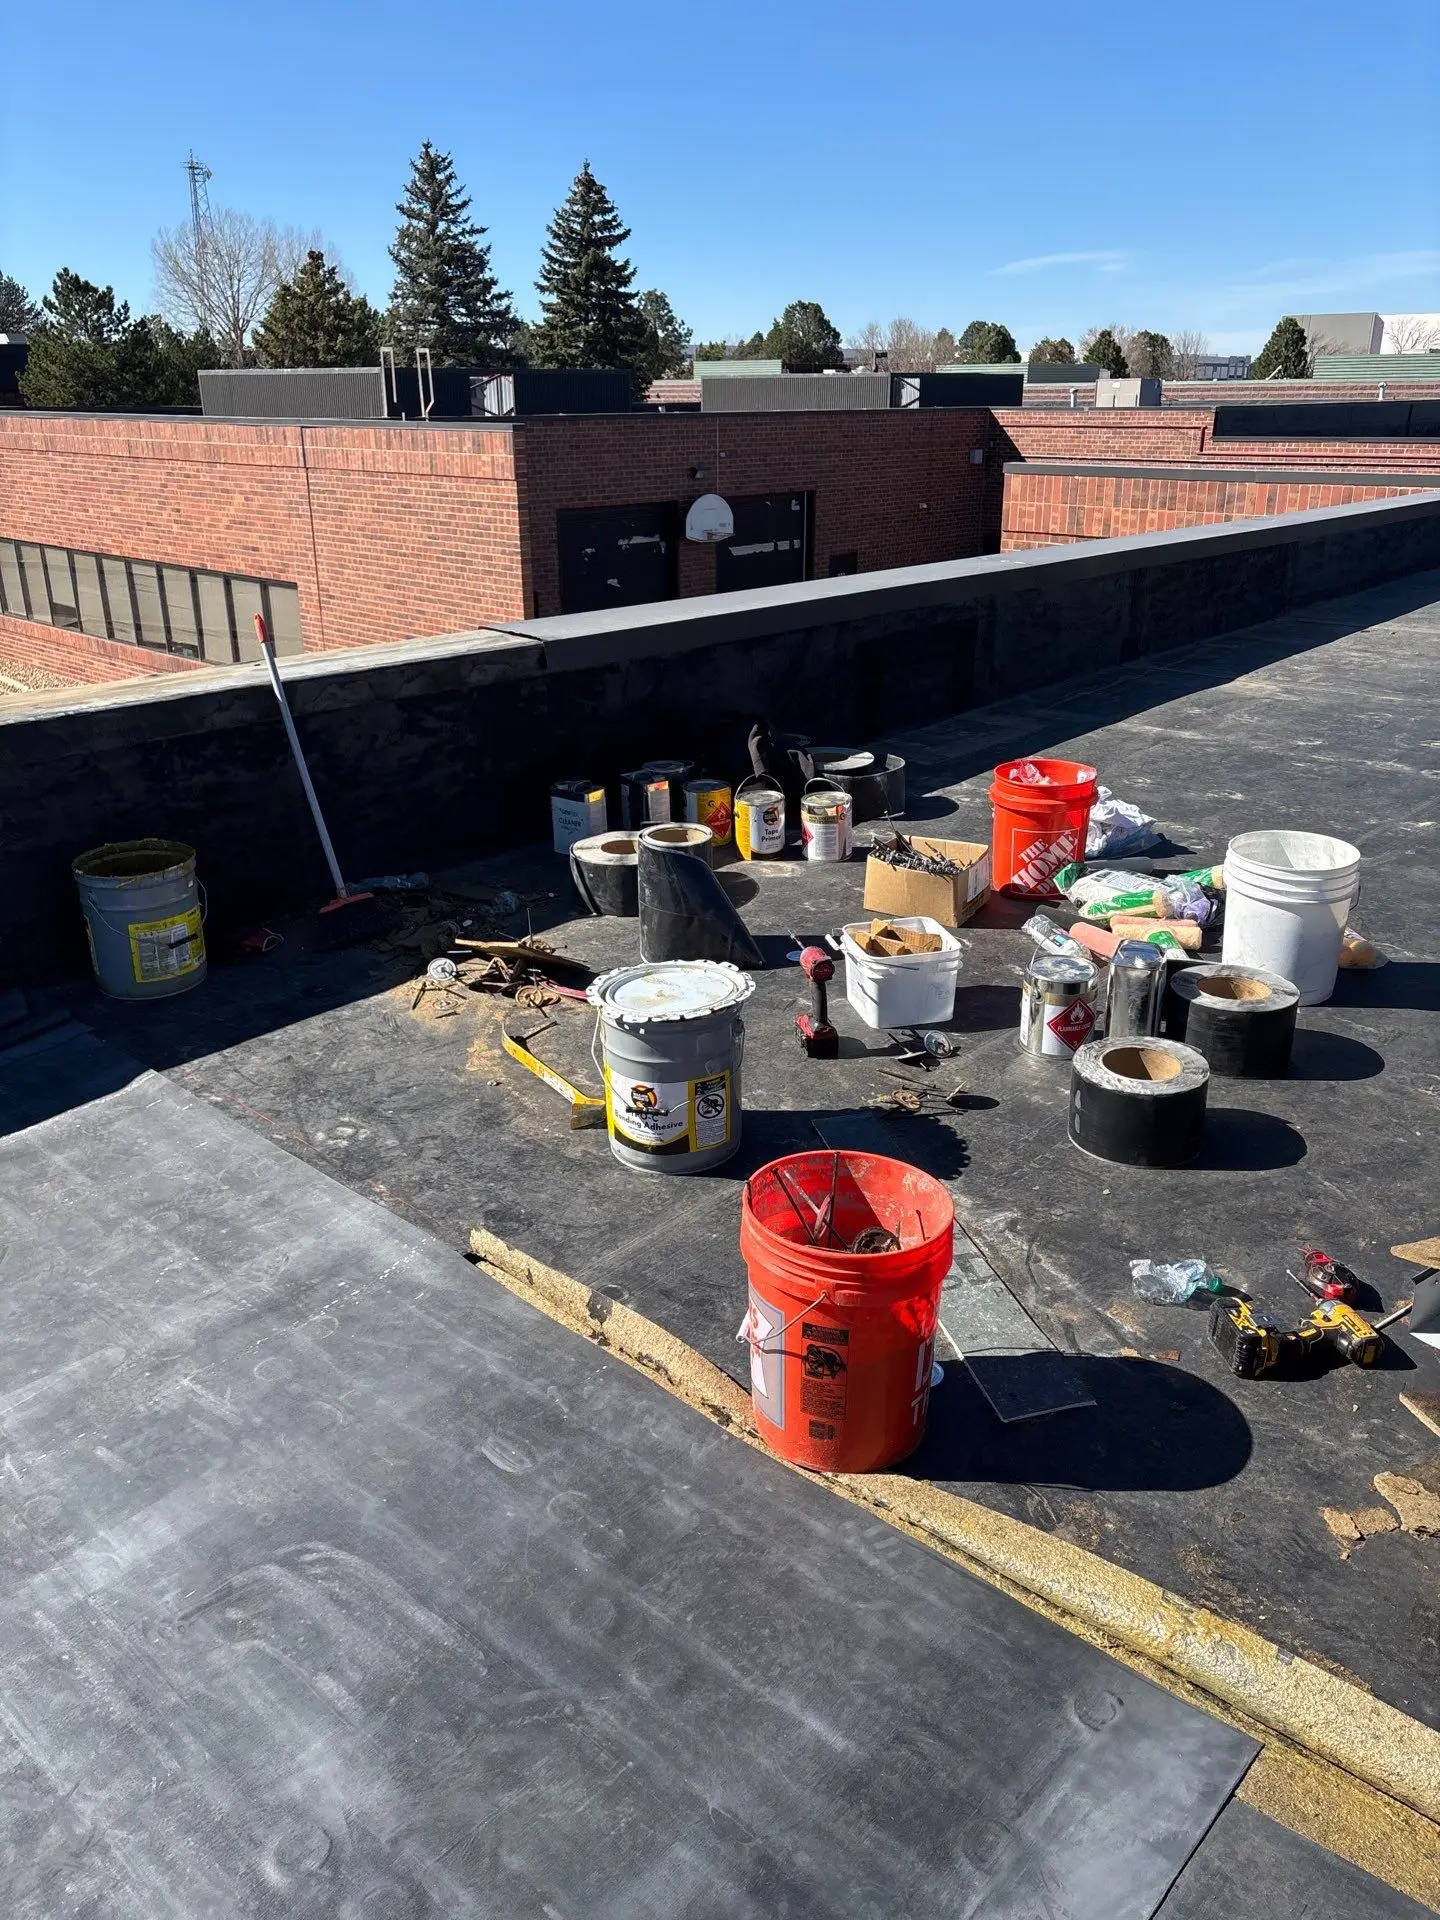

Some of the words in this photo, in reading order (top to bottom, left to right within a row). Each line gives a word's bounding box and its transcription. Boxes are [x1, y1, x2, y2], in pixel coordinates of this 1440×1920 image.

[558, 817, 582, 828] CLEANER
[764, 828, 779, 836] Tape
[761, 834, 782, 842] Primer
[1018, 838, 1048, 863] THE
[1012, 830, 1078, 893] HOME
[615, 1109, 642, 1128] Bonding
[643, 1121, 684, 1131] Adhesive
